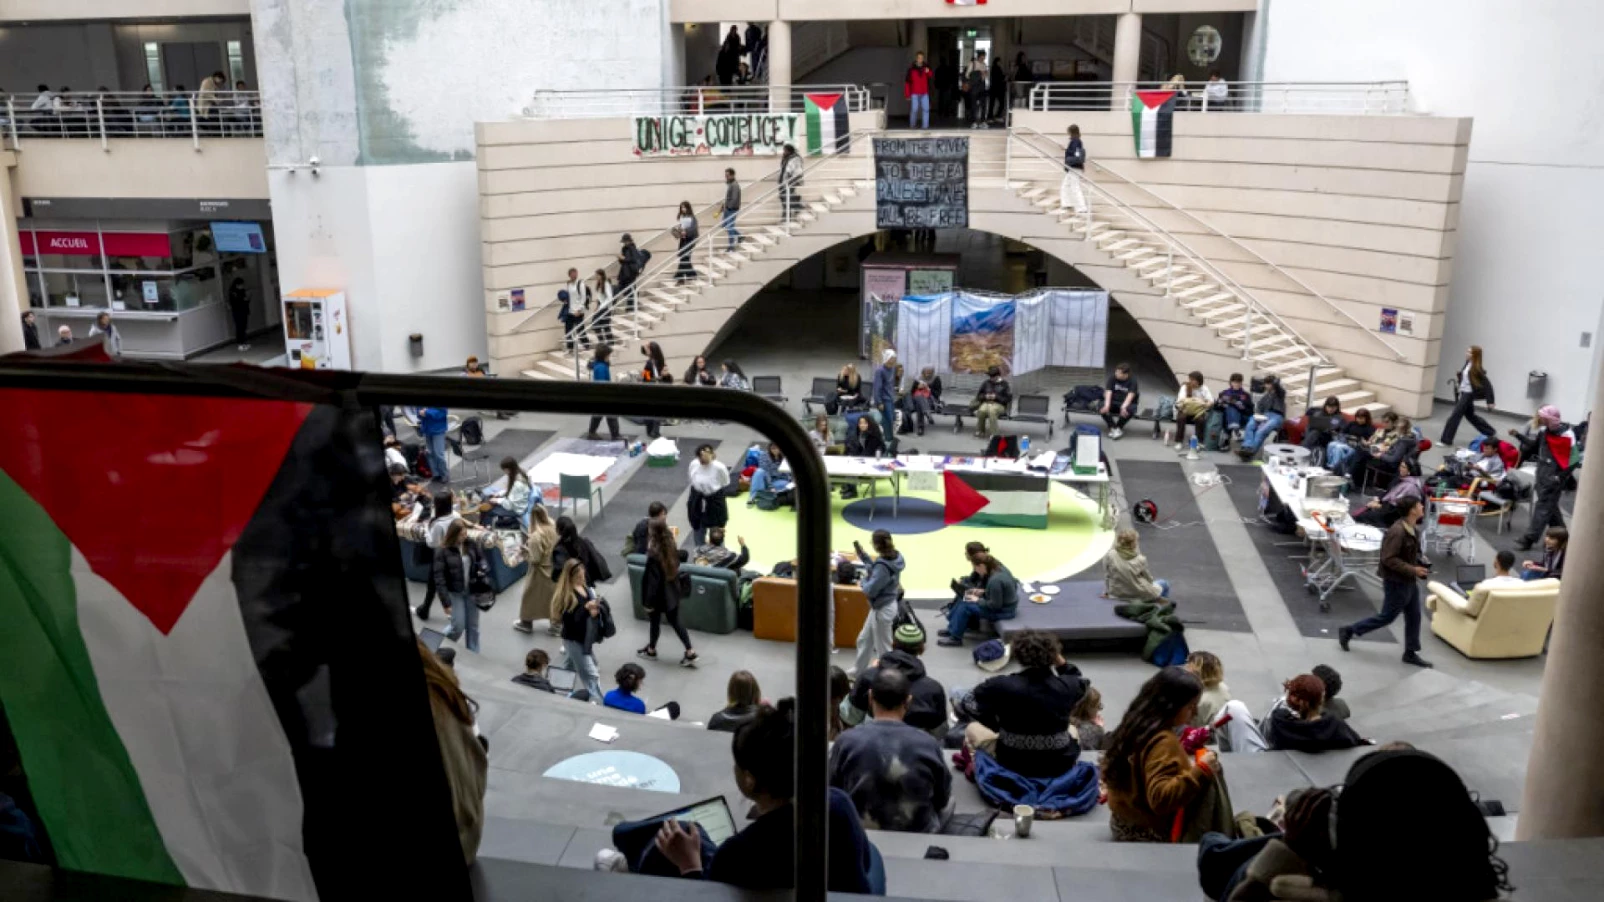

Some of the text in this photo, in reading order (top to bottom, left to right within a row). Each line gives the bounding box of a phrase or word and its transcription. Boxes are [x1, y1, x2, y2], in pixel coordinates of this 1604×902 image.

[635, 115, 695, 151] UNIGE
[875, 138, 968, 154] FROM THE RIVER
[883, 163, 962, 178] TO THE SEA
[929, 207, 965, 225] FREE
[50, 237, 88, 249] ACCUEIL
